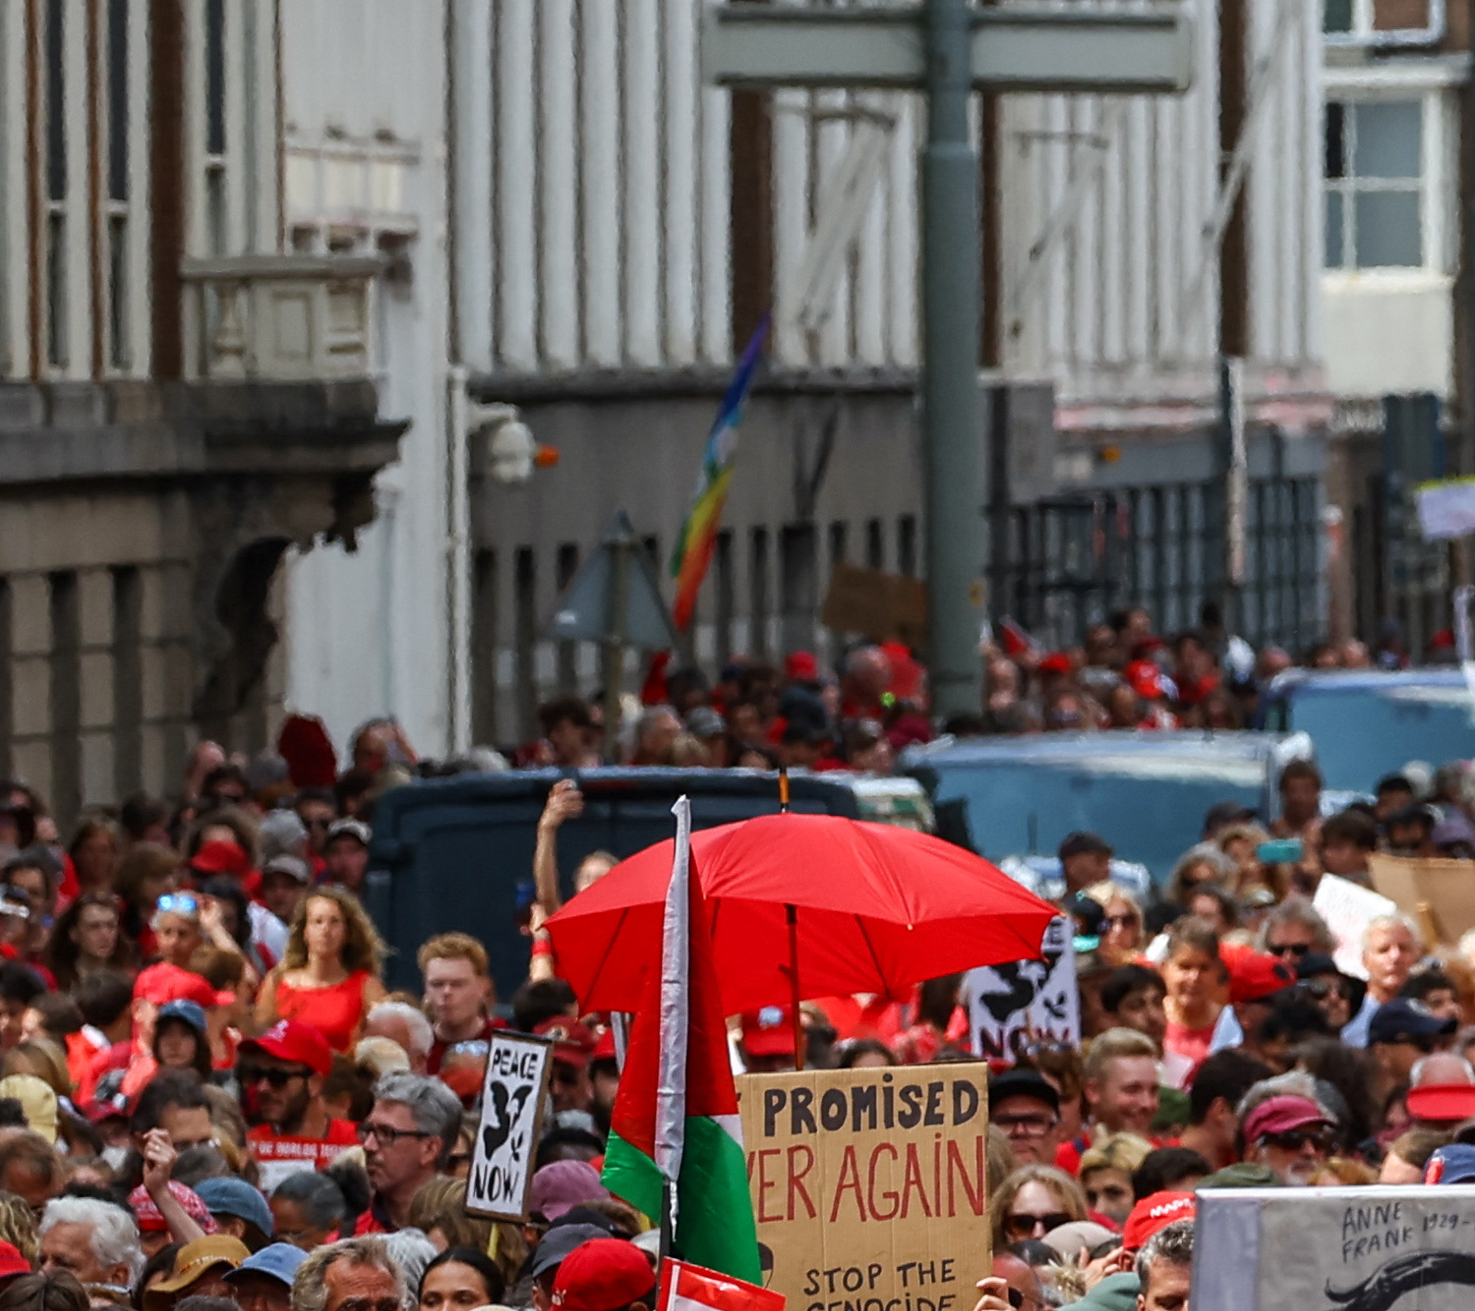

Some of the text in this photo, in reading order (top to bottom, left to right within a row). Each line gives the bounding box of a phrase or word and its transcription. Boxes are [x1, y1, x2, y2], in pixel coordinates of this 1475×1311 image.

[491, 1048, 539, 1081] PEACE
[472, 1164, 520, 1203] NOW
[1341, 1202, 1402, 1238] ANNE
[1342, 1226, 1415, 1264] FRANK
[803, 1258, 956, 1296] STOP THE
